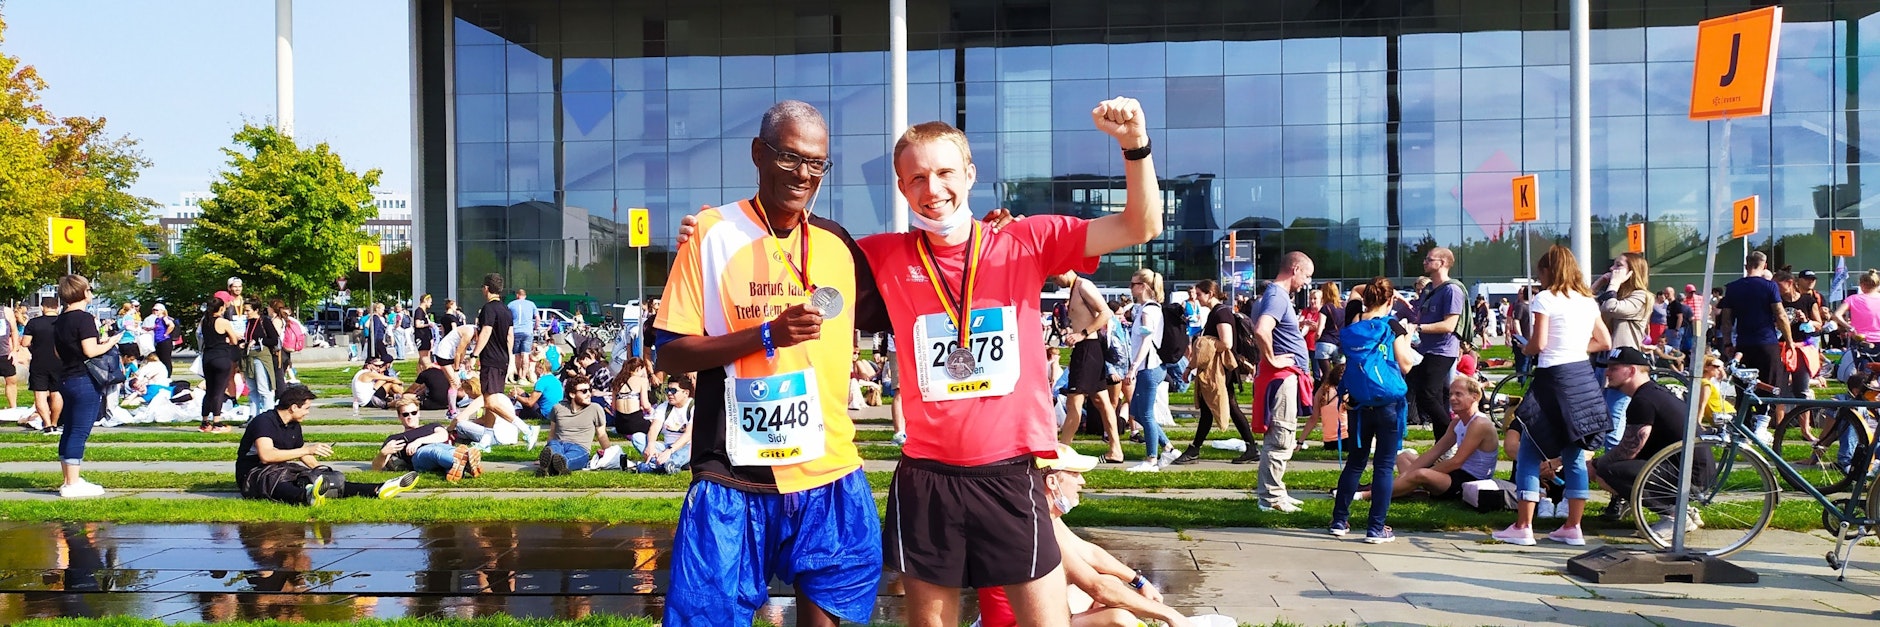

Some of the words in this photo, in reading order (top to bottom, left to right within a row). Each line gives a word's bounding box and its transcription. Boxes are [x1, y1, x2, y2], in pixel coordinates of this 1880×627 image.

[1719, 32, 1741, 88] J
[1520, 184, 1528, 208] K
[1740, 205, 1749, 225] O
[637, 216, 643, 235] G
[64, 225, 74, 244] C
[1633, 230, 1638, 244] P
[1839, 235, 1845, 249] T
[367, 250, 374, 264] D
[735, 303, 760, 320] Trete
[950, 384, 975, 392] Giti
[742, 400, 809, 433] 52448
[767, 433, 787, 445] Sidy
[760, 450, 785, 458] Giti
